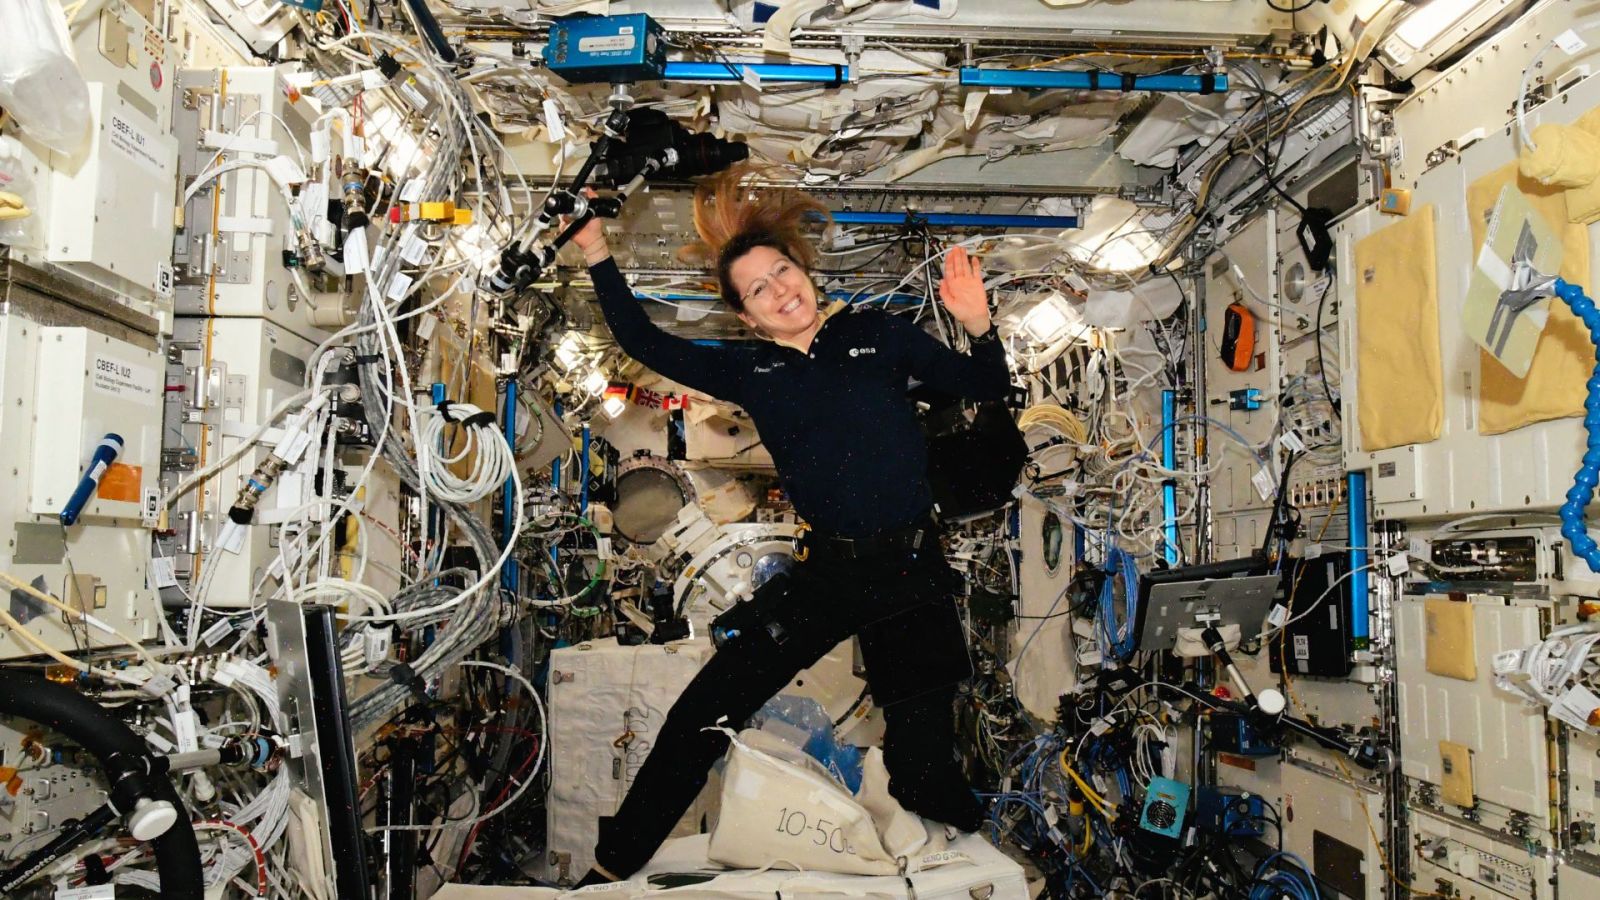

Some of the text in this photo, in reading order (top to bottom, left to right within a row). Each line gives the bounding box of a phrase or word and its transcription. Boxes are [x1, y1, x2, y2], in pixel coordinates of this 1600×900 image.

[112, 116, 135, 140] CBEF-L
[96, 358, 131, 378] CBEF-L IU2
[2, 854, 56, 892] Manfrotto
